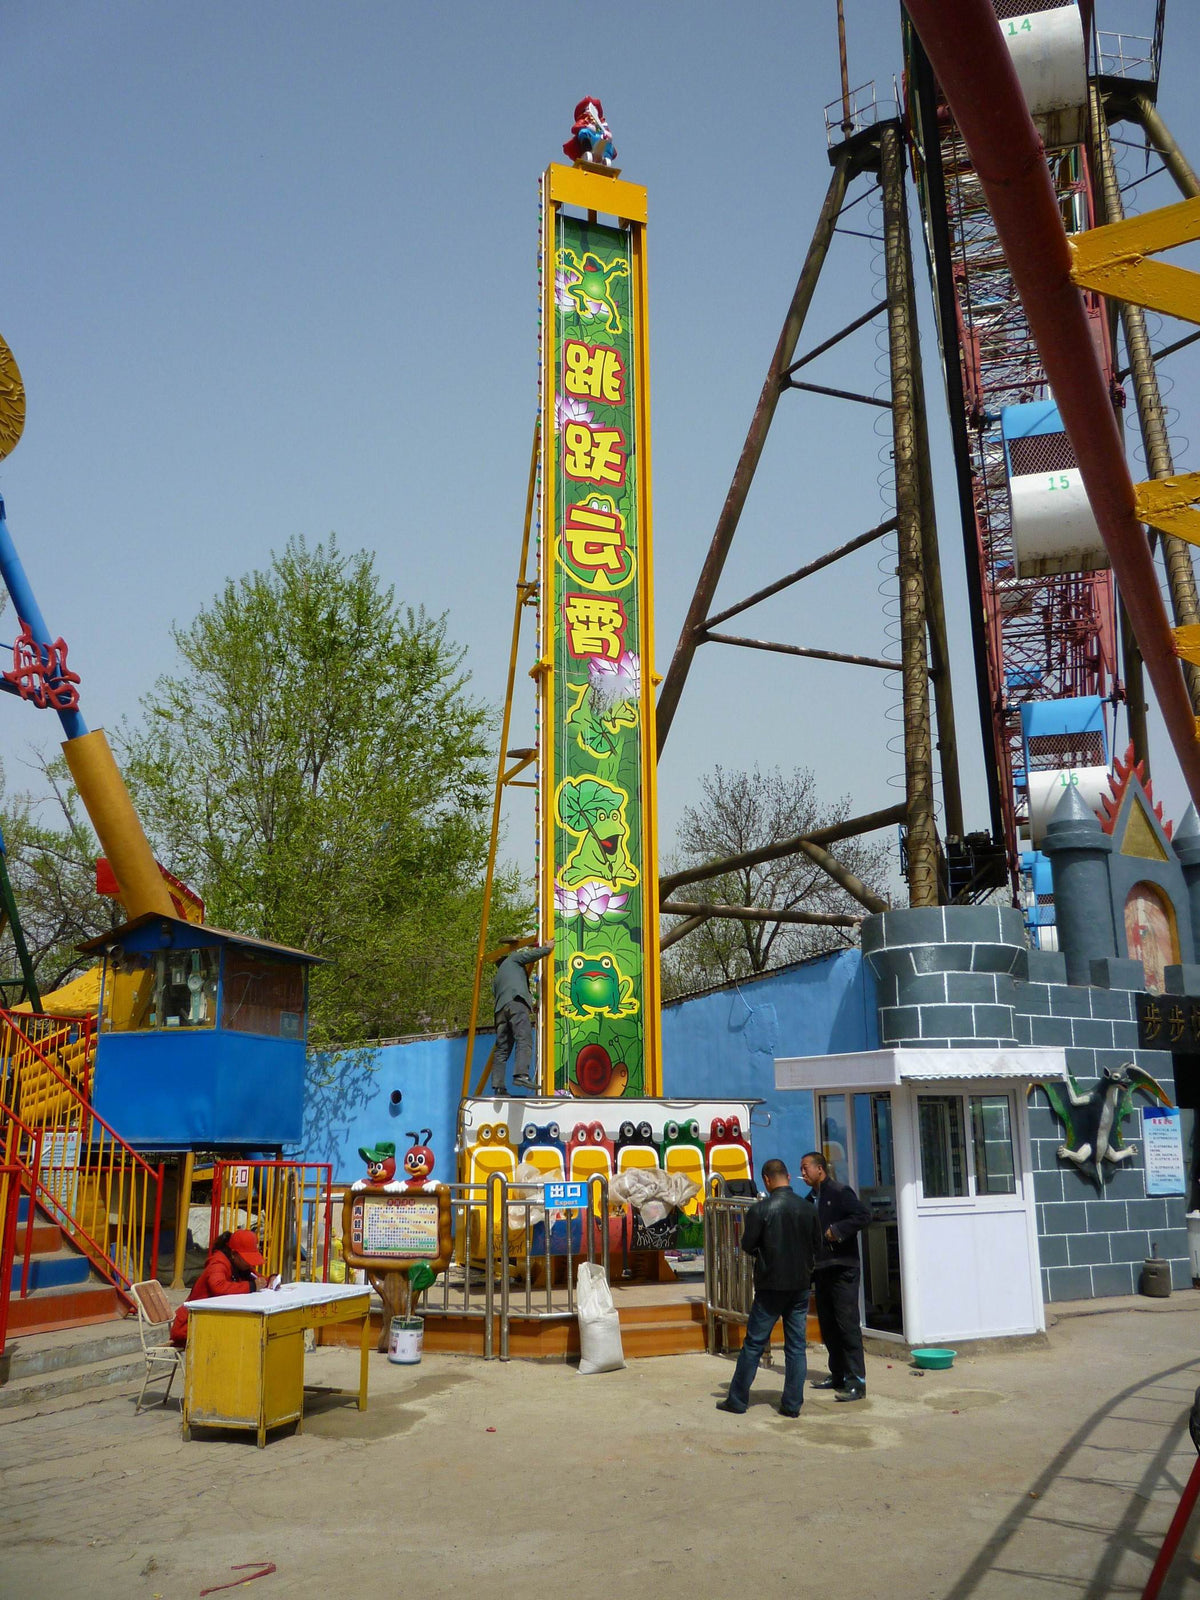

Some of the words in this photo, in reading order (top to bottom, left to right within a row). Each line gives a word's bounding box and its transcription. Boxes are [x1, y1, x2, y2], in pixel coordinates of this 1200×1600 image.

[1008, 19, 1032, 36] 14
[1048, 475, 1070, 491] 15
[564, 342, 624, 660] 跳跃云霄
[1060, 773, 1079, 787] 16
[550, 1184, 581, 1198] 出口
